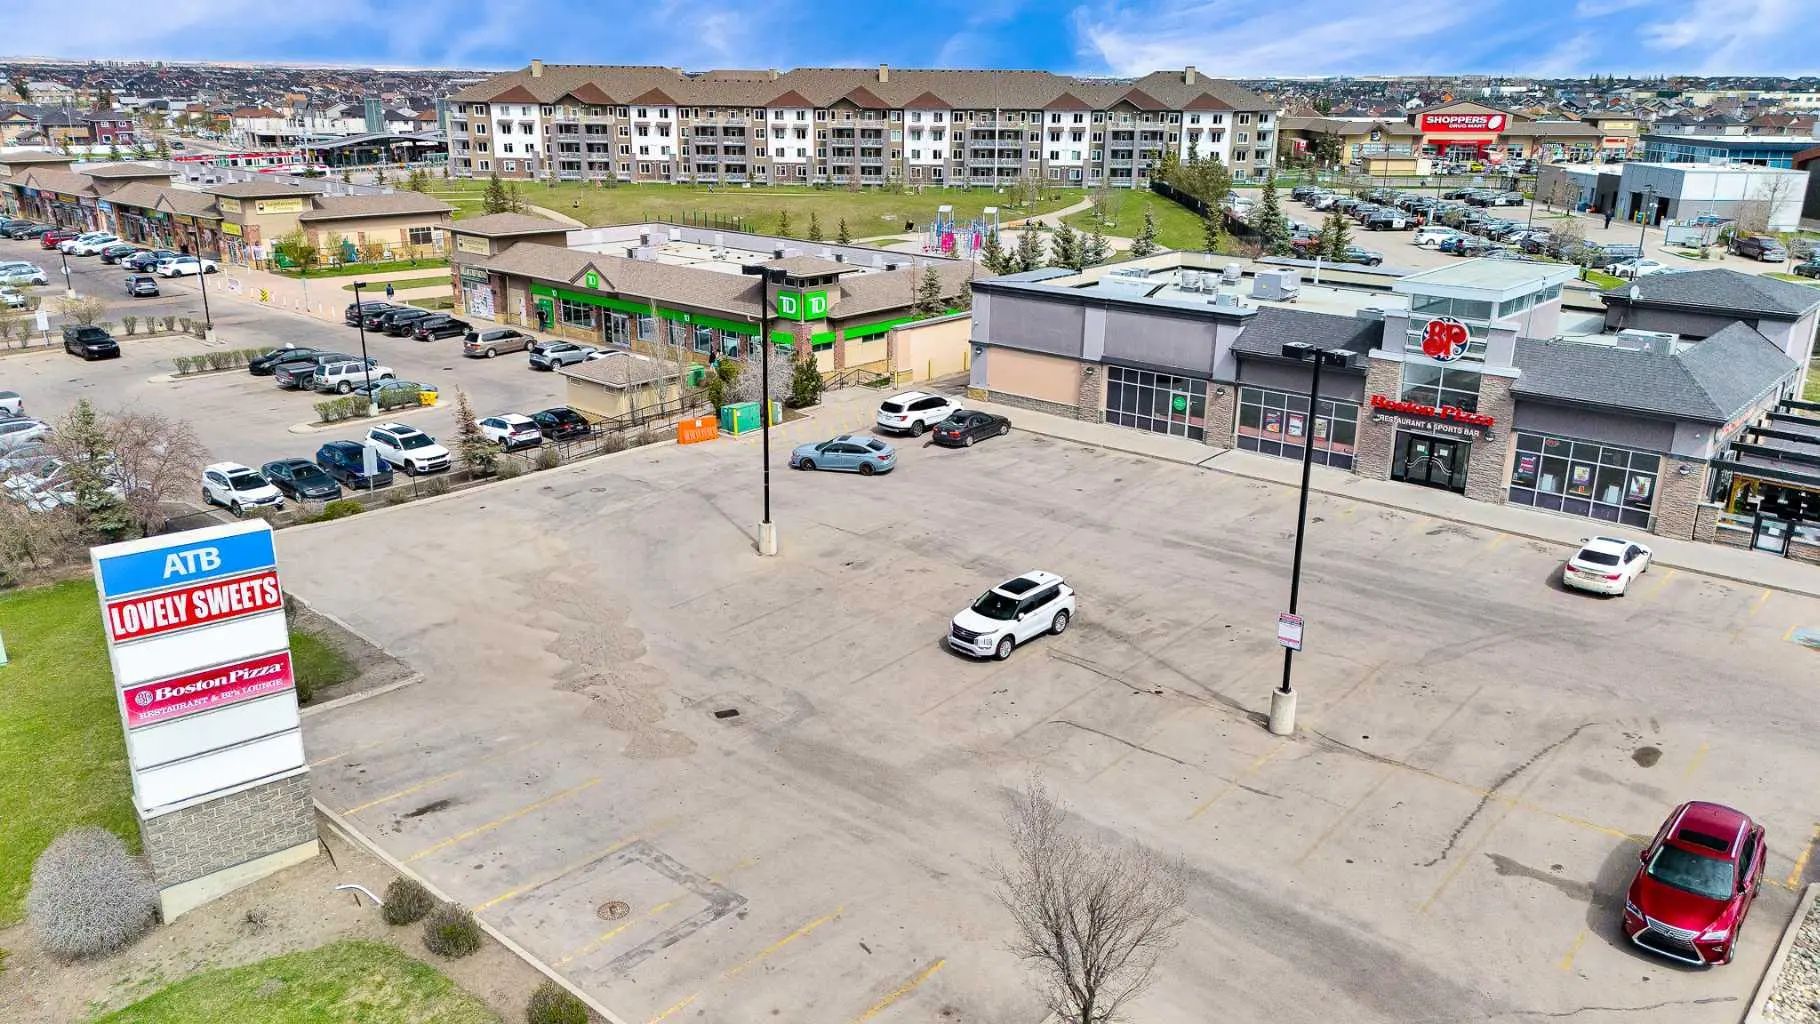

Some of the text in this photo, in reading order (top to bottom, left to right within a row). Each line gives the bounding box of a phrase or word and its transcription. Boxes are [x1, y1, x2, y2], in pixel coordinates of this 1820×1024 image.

[1426, 116, 1487, 124] SHOPPERS
[780, 295, 797, 314] TD
[809, 296, 826, 315] TD
[1370, 394, 1496, 427] Boston Pizza
[1379, 414, 1480, 437] RESTAURANT & SPORTS BAR
[163, 547, 221, 579] ATB
[110, 576, 278, 636] LOVELY SWEETS
[154, 664, 281, 701] Boston Pizza
[138, 696, 208, 720] RESTAURANT
[211, 694, 219, 703] &
[242, 679, 284, 696] LOUNGE
